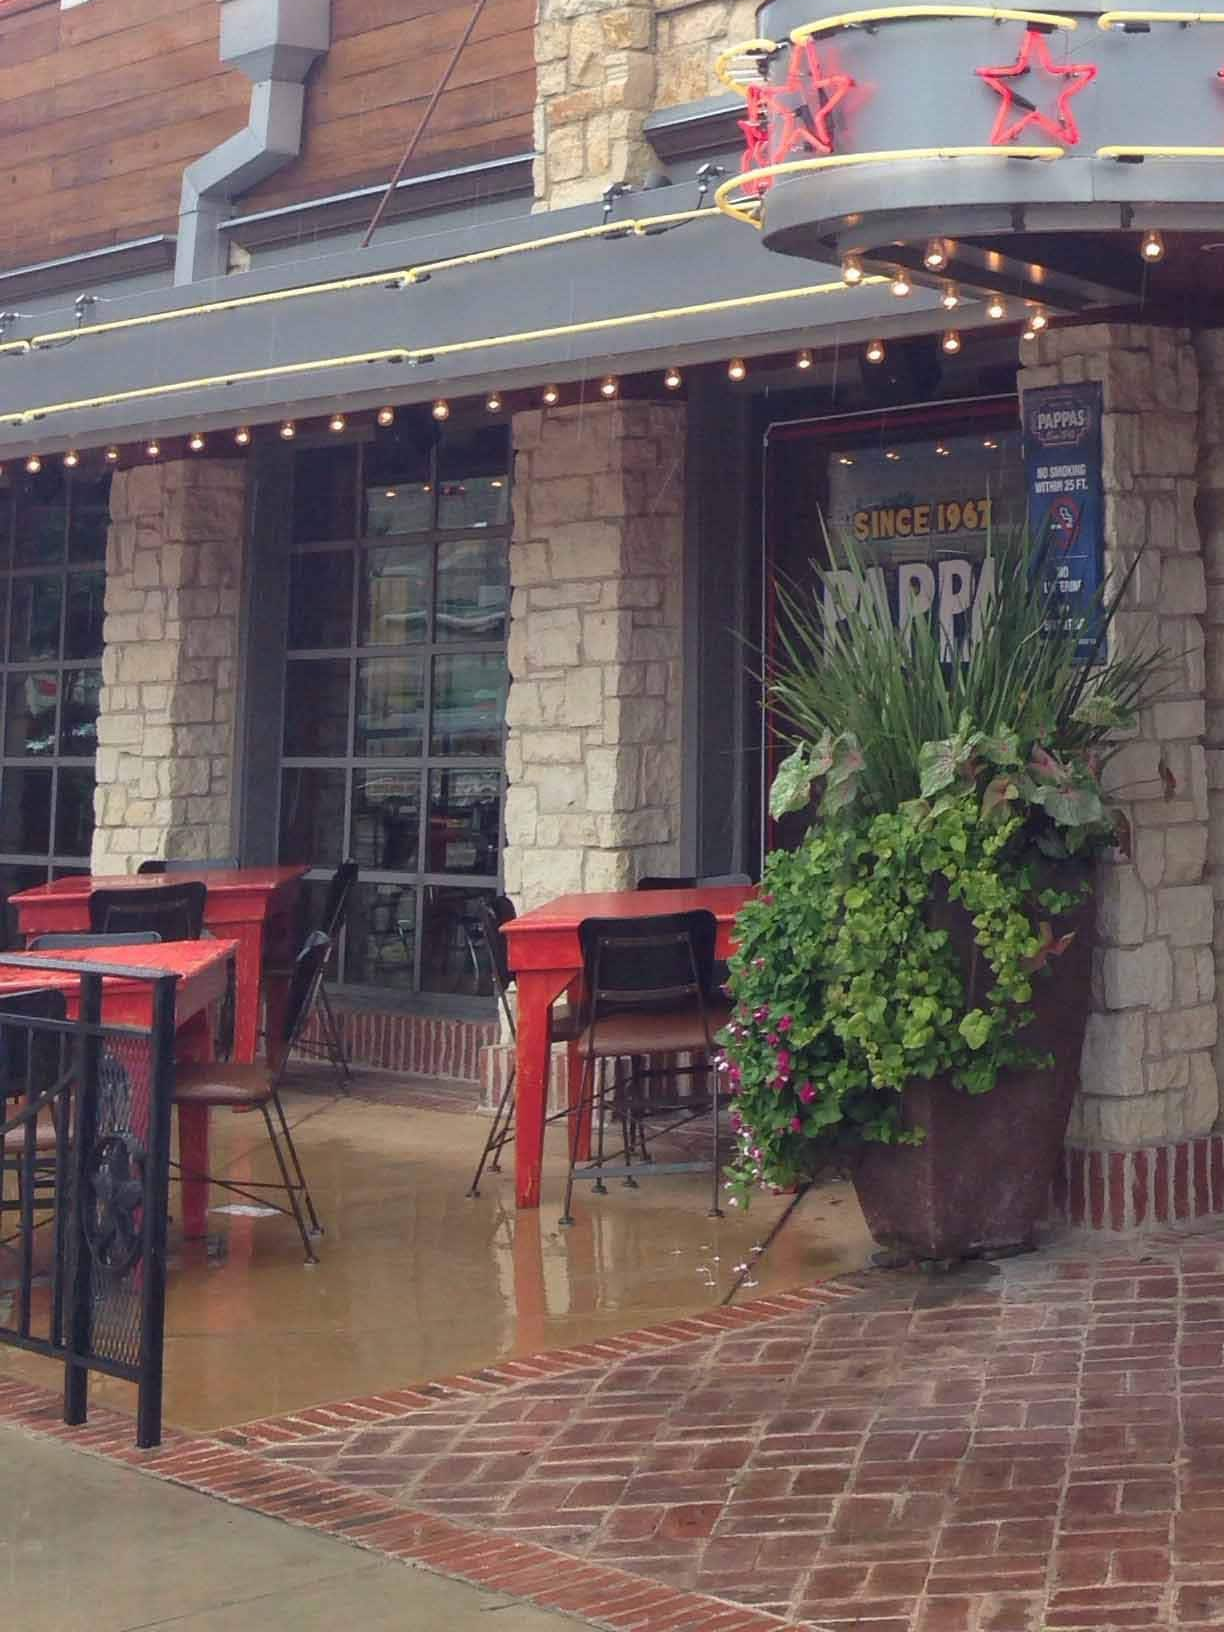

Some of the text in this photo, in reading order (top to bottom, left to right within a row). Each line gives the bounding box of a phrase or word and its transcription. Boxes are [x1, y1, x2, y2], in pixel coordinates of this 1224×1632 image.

[1037, 409, 1085, 429] PAPPAS
[1036, 466, 1049, 480] NO
[852, 503, 931, 542] SINCE
[822, 555, 998, 667] PAPPA
